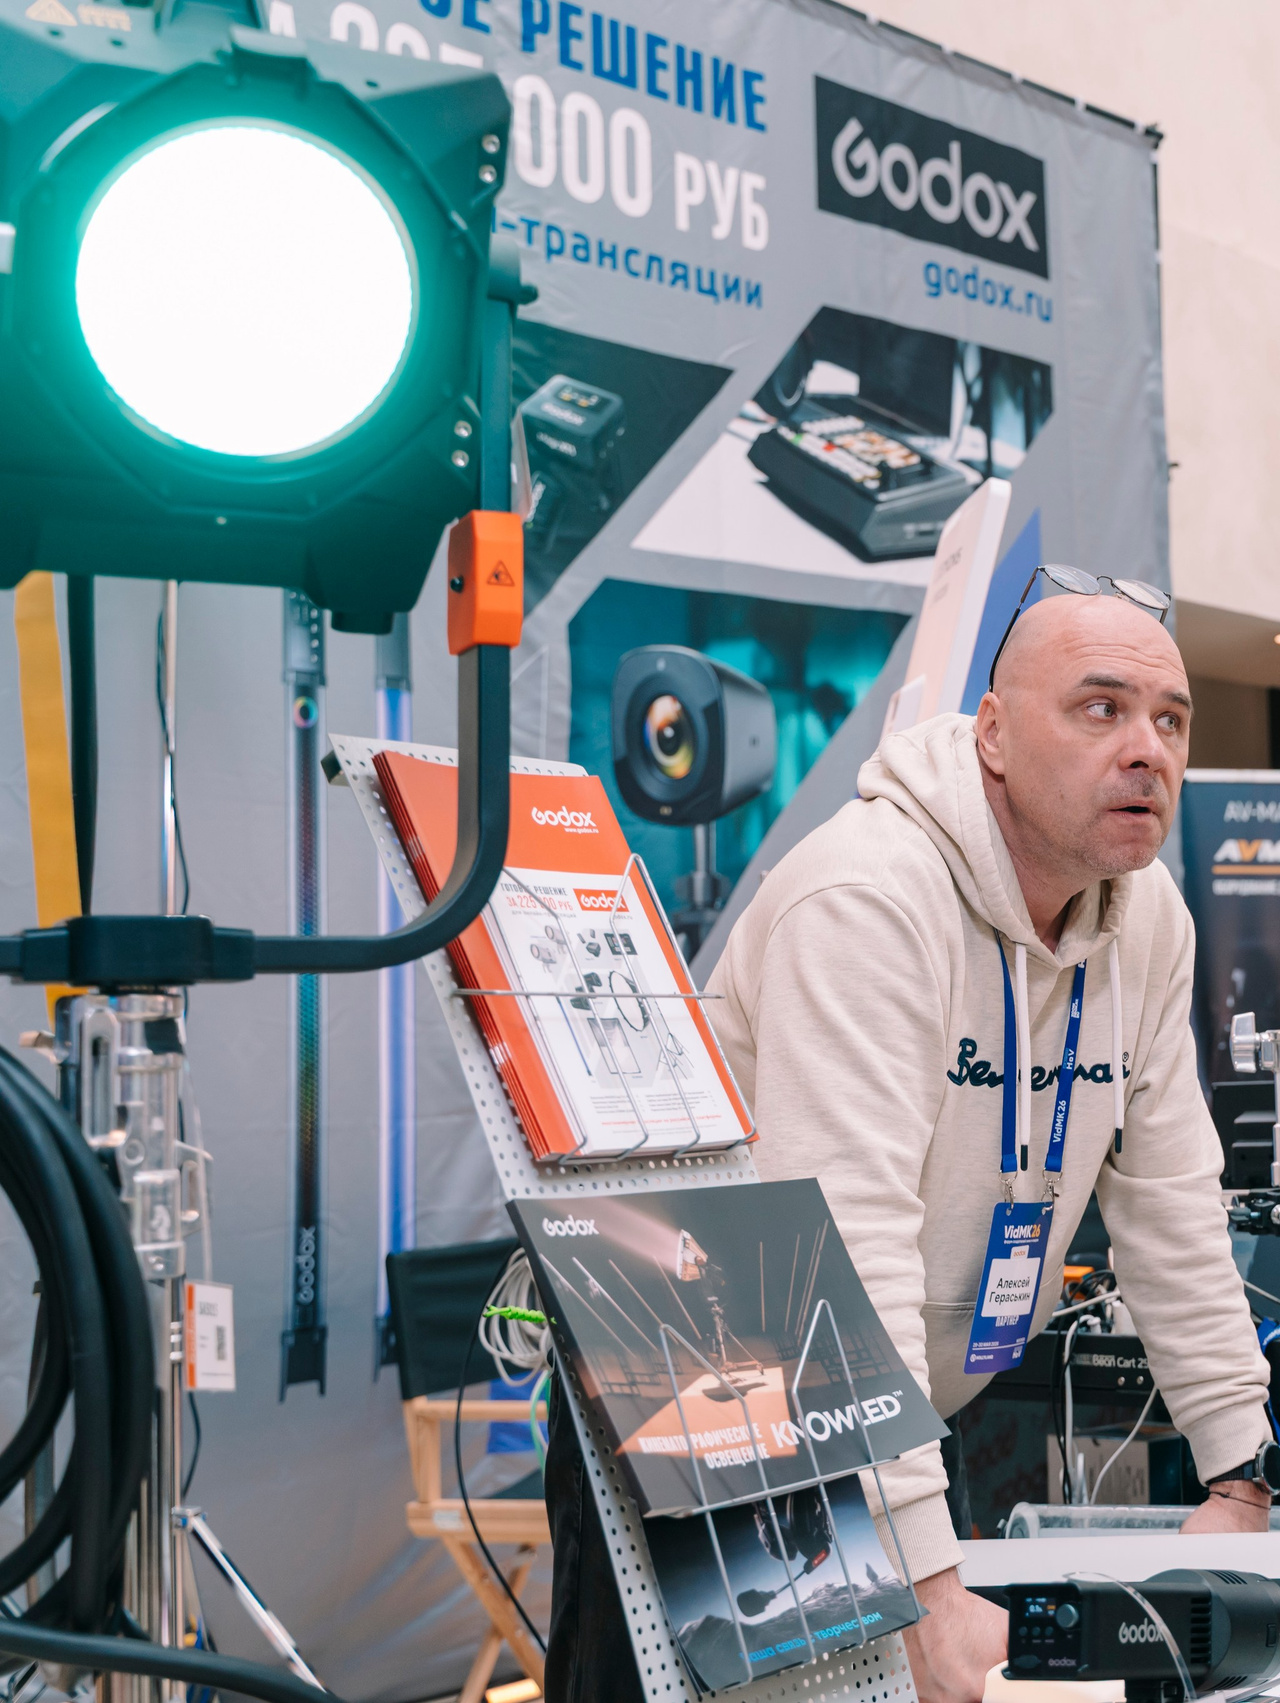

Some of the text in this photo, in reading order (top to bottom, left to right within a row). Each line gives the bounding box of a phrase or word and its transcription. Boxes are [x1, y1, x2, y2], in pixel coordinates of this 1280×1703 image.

[520, 0, 767, 133] РЕШЕНИЕ
[831, 115, 1040, 253] Godox
[674, 150, 770, 252] РУБ
[923, 261, 1054, 324] godox.ru
[531, 805, 598, 829] Godox
[542, 1214, 600, 1237] Godox
[1004, 1224, 1041, 1239] VidMK26
[295, 1225, 316, 1305] Godox
[996, 1276, 1030, 1289] Алексей
[988, 1291, 1031, 1306] Гераськин
[995, 1314, 1020, 1327] ПАРТНЕР
[814, 1611, 883, 1642] творчесвом
[1118, 1617, 1166, 1645] Godox
[1048, 1656, 1077, 1667] Godox
